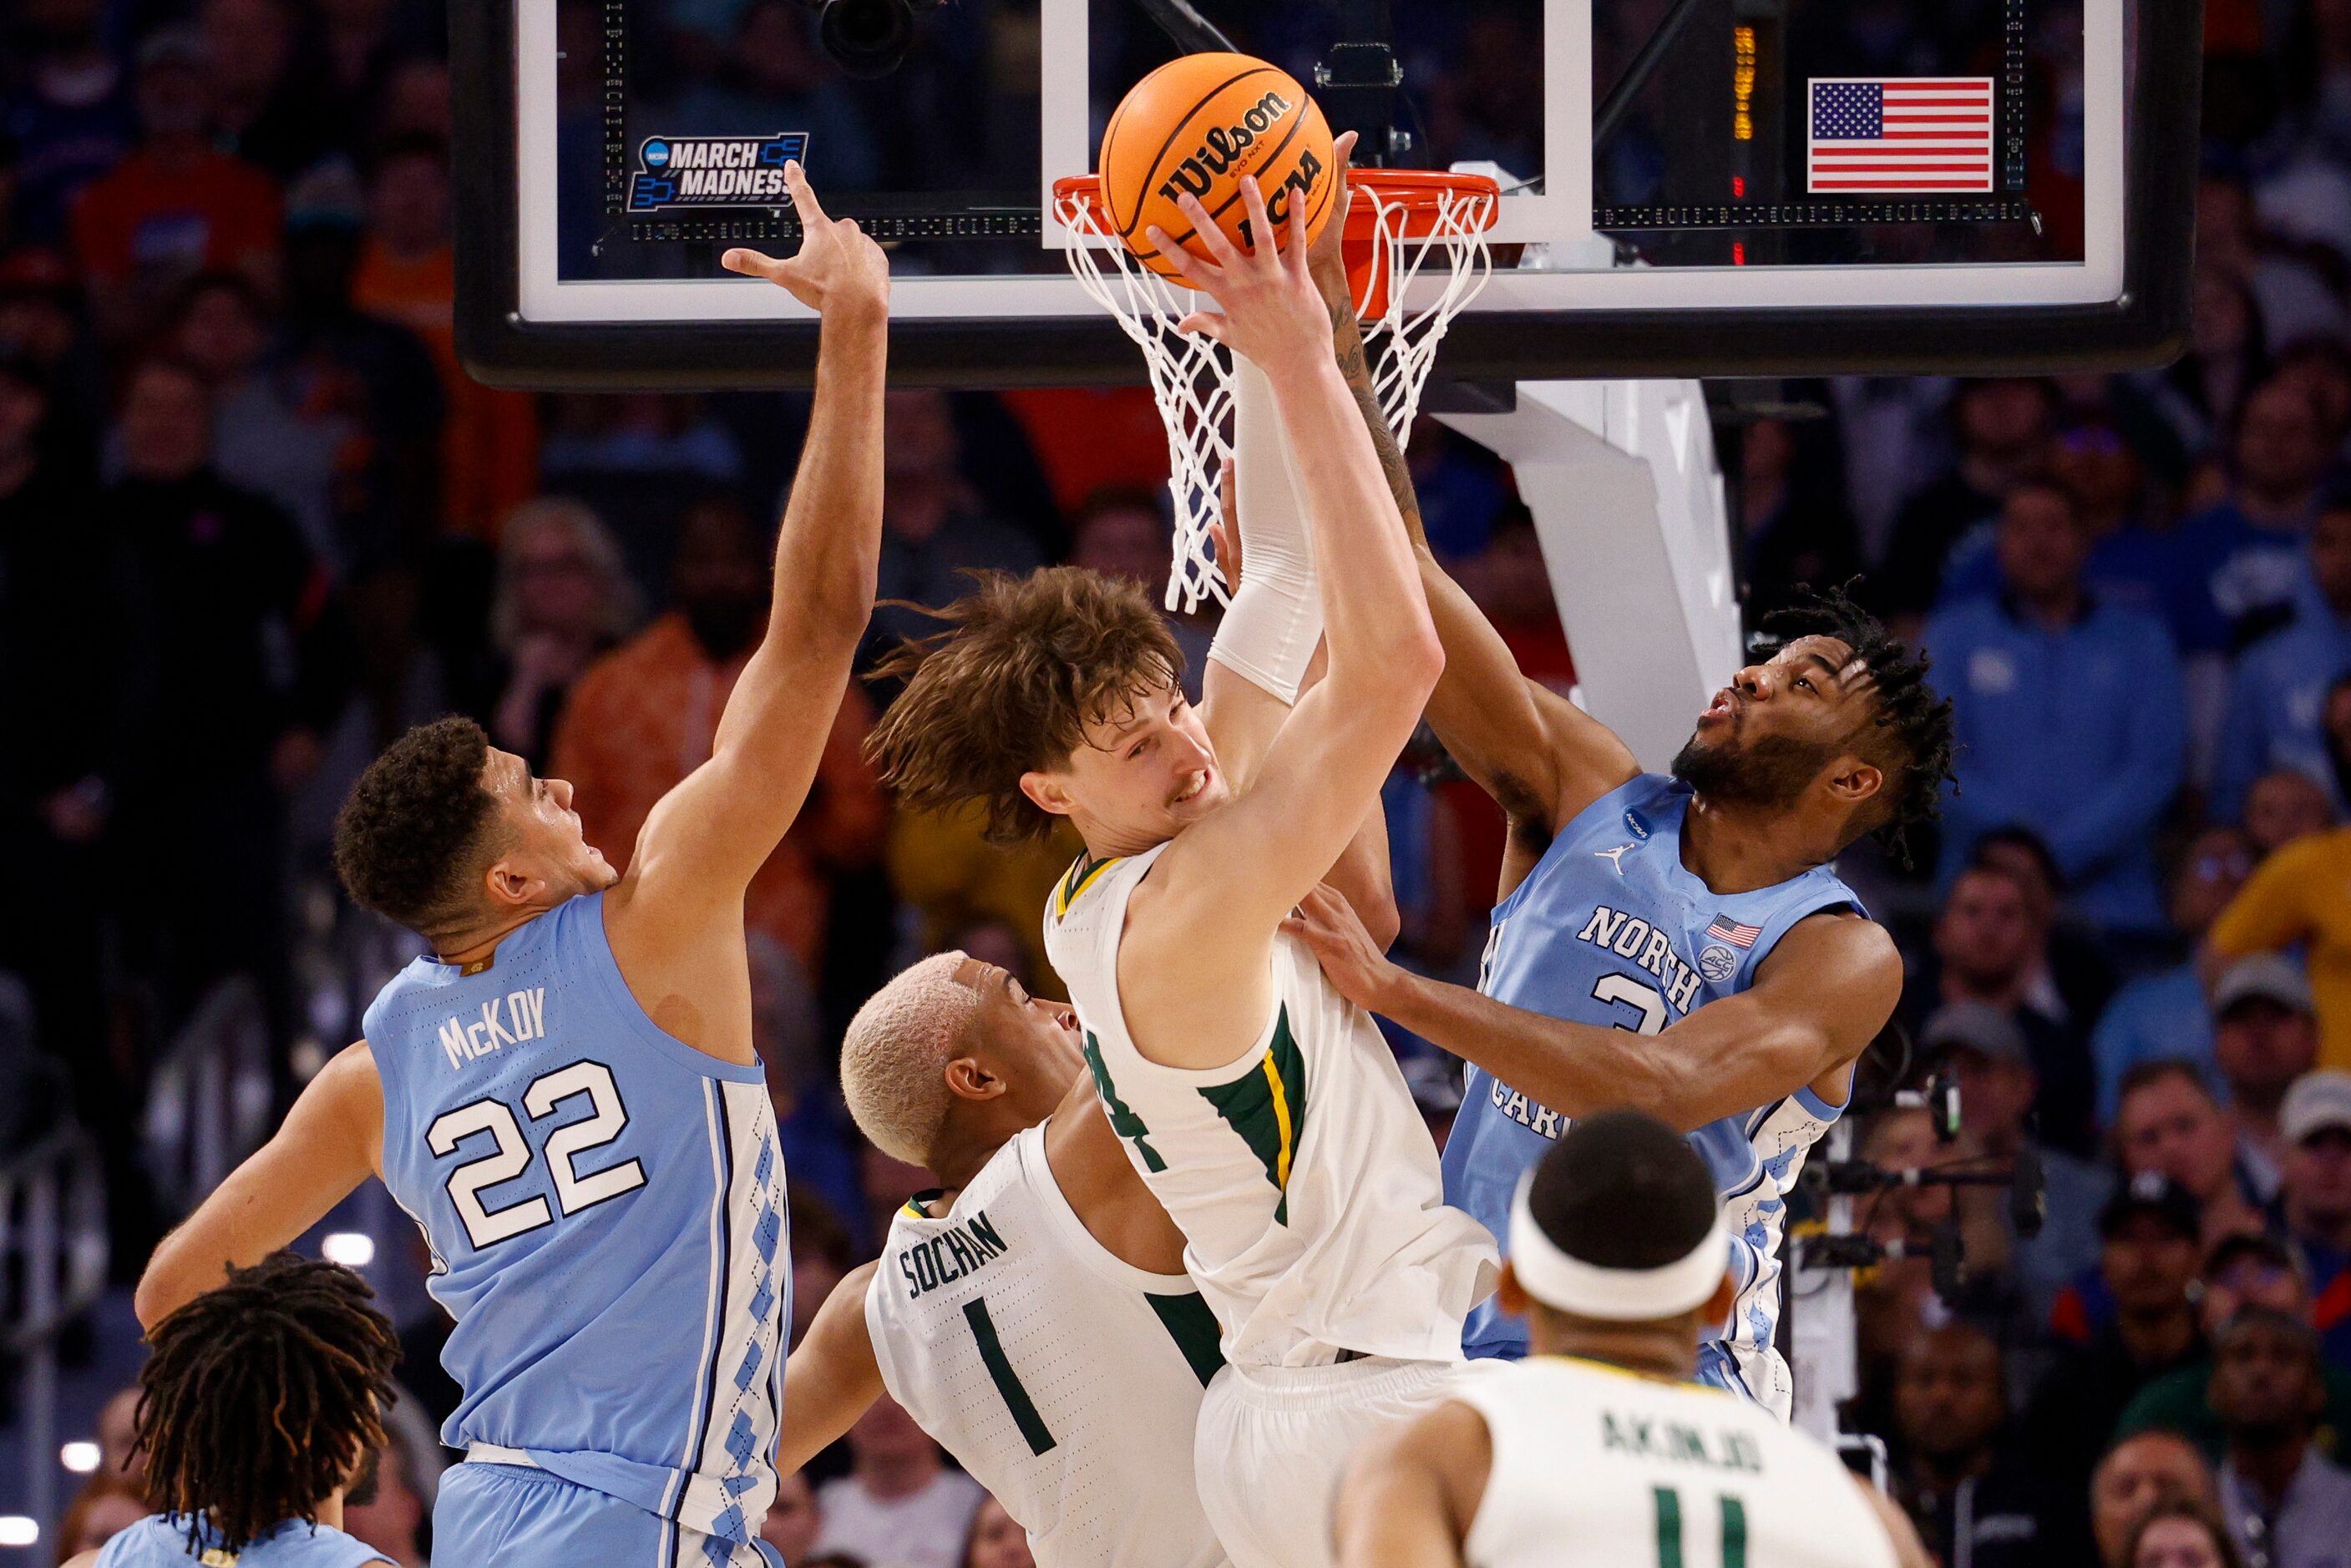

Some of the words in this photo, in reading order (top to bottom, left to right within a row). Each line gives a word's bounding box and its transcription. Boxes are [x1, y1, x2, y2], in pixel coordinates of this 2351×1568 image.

[669, 143, 759, 169] MARCH
[1158, 91, 1292, 206] Wilson
[1625, 813, 1648, 838] NCAA
[1575, 905, 1704, 1016] NORTH
[1705, 955, 1734, 973] ACC
[438, 987, 545, 1070] McKOY
[424, 1058, 649, 1252] 22
[899, 1210, 1008, 1299] SOCHAN
[962, 1296, 1057, 1457] 1
[1652, 1485, 1747, 1568] 11
